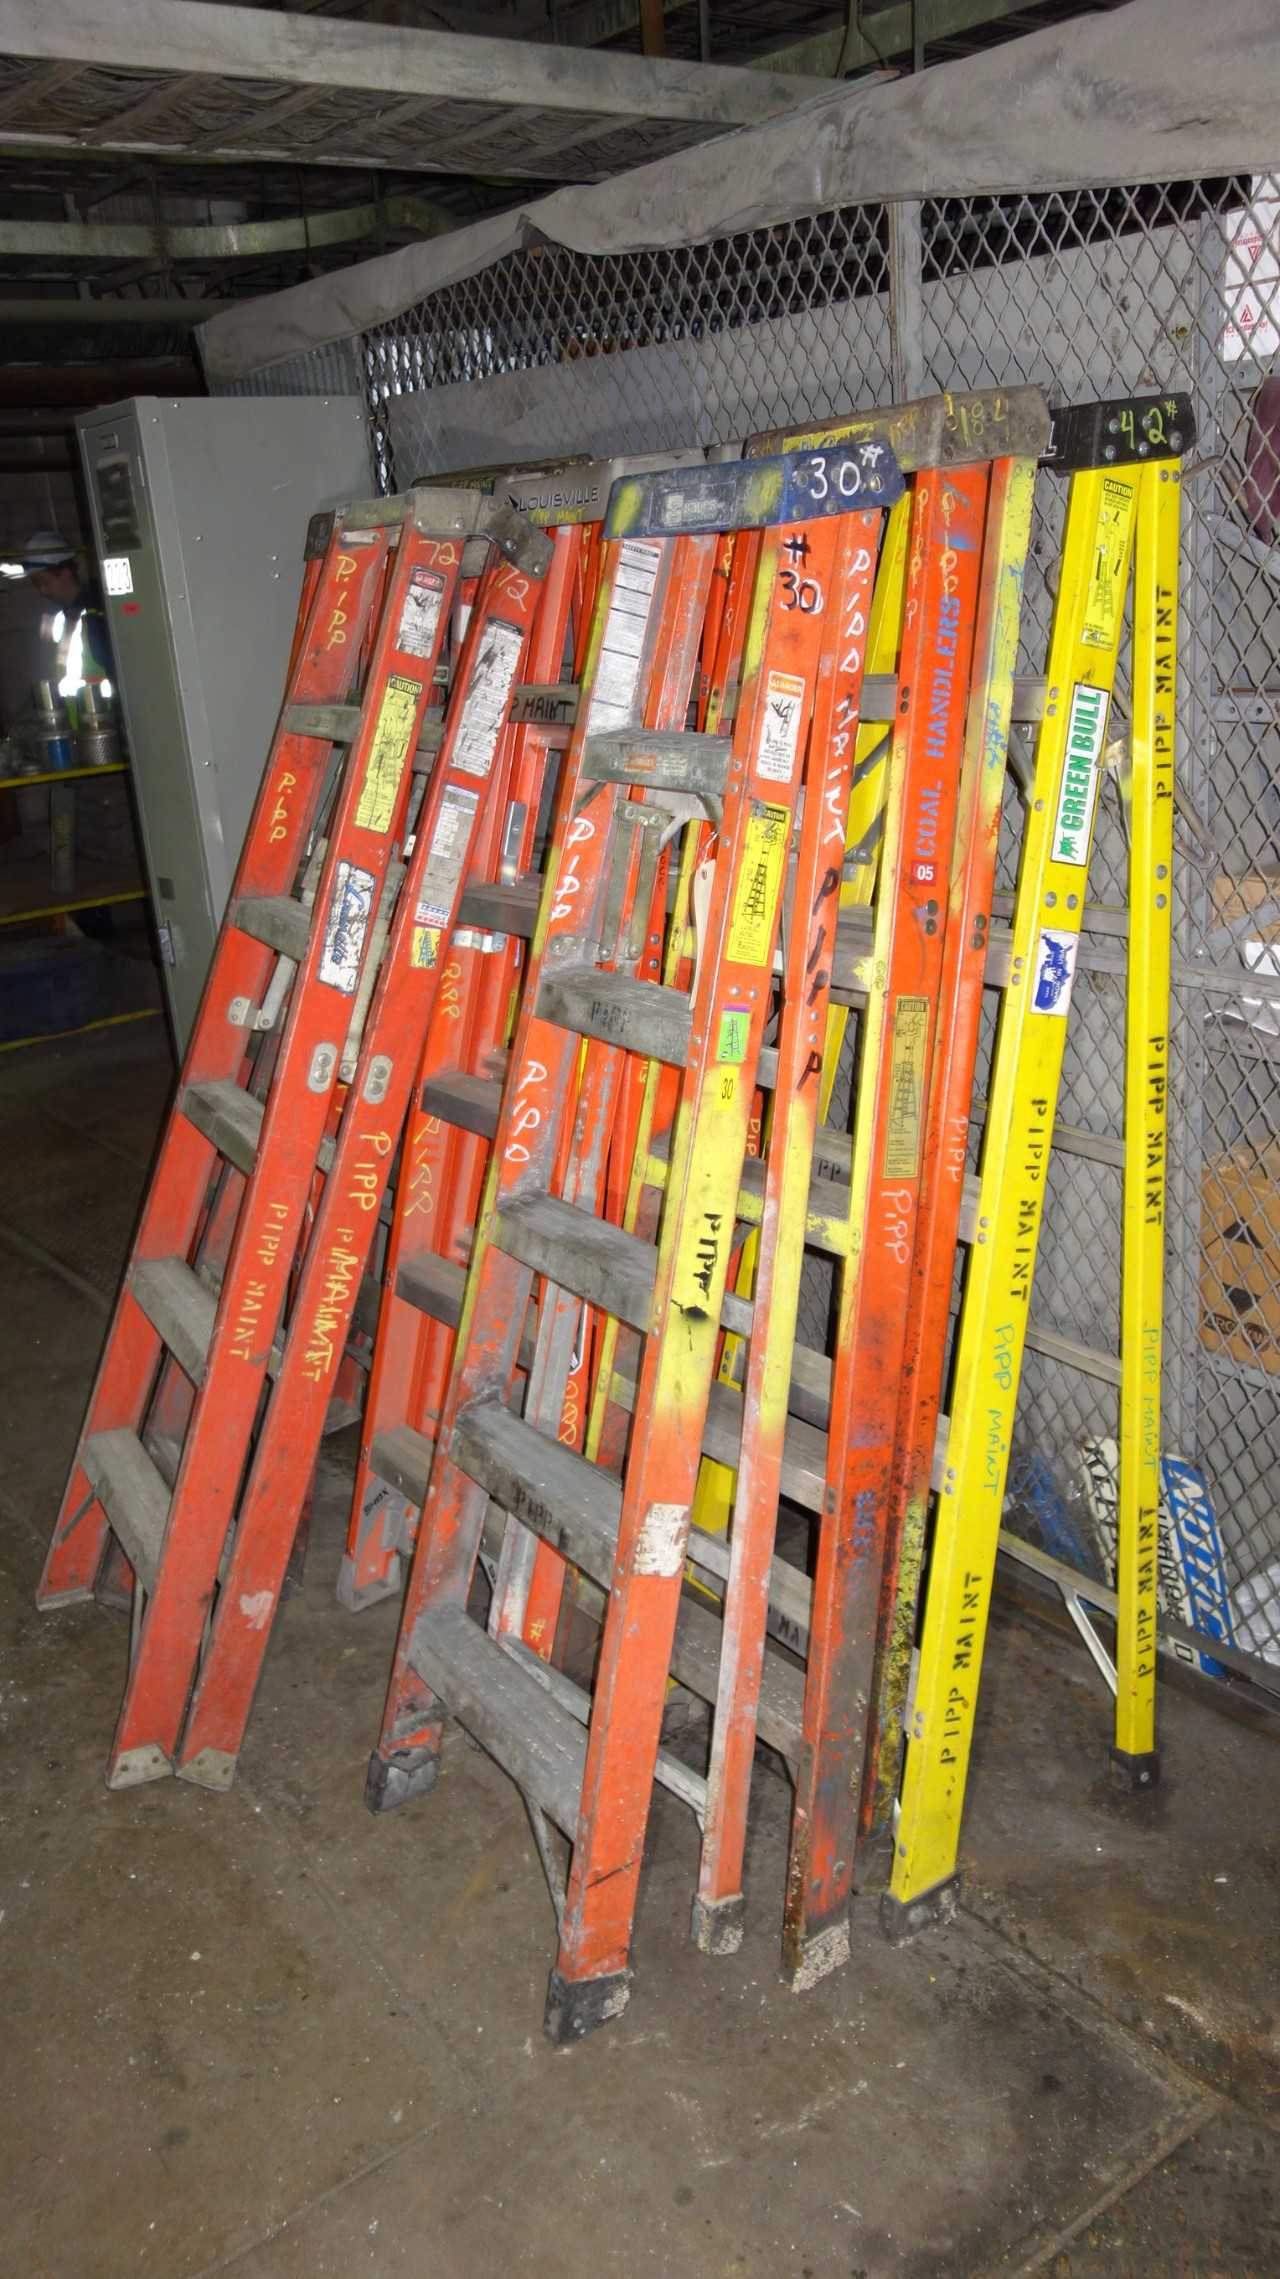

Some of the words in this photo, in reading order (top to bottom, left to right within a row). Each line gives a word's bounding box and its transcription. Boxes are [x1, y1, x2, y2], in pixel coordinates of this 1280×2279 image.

[518, 486, 600, 513] LOUISVILLE
[1103, 478, 1134, 499] CAUTION
[418, 539, 461, 566] 72
[497, 561, 529, 612] 72
[779, 570, 824, 615] 30
[924, 595, 961, 759] HANDLERS
[1154, 585, 1173, 694] MAINT
[389, 677, 424, 697] CAUTION
[523, 696, 574, 723] MAINT
[1071, 691, 1103, 754] BULL
[1060, 753, 1096, 833] GREEN
[1154, 712, 1173, 799] PIPP
[915, 780, 943, 858] COAL
[916, 864, 935, 882] 05
[721, 1077, 735, 1101] 30
[1147, 1035, 1166, 1116] PIPP
[349, 1130, 393, 1213] PIPP
[1023, 1098, 1049, 1182] PIPP
[1144, 1130, 1164, 1226] MAINT
[256, 1202, 290, 1267] PIPP
[1009, 1198, 1038, 1303] MAINT
[228, 1280, 268, 1362] MAINT
[991, 1321, 1016, 1393] PIPP
[1142, 1326, 1161, 1386] PIPP
[1136, 1505, 1156, 1596] MAINT
[952, 1571, 983, 1672] MAINT
[1136, 1609, 1154, 1679] PIPP
[939, 1685, 966, 1767] PIPP
